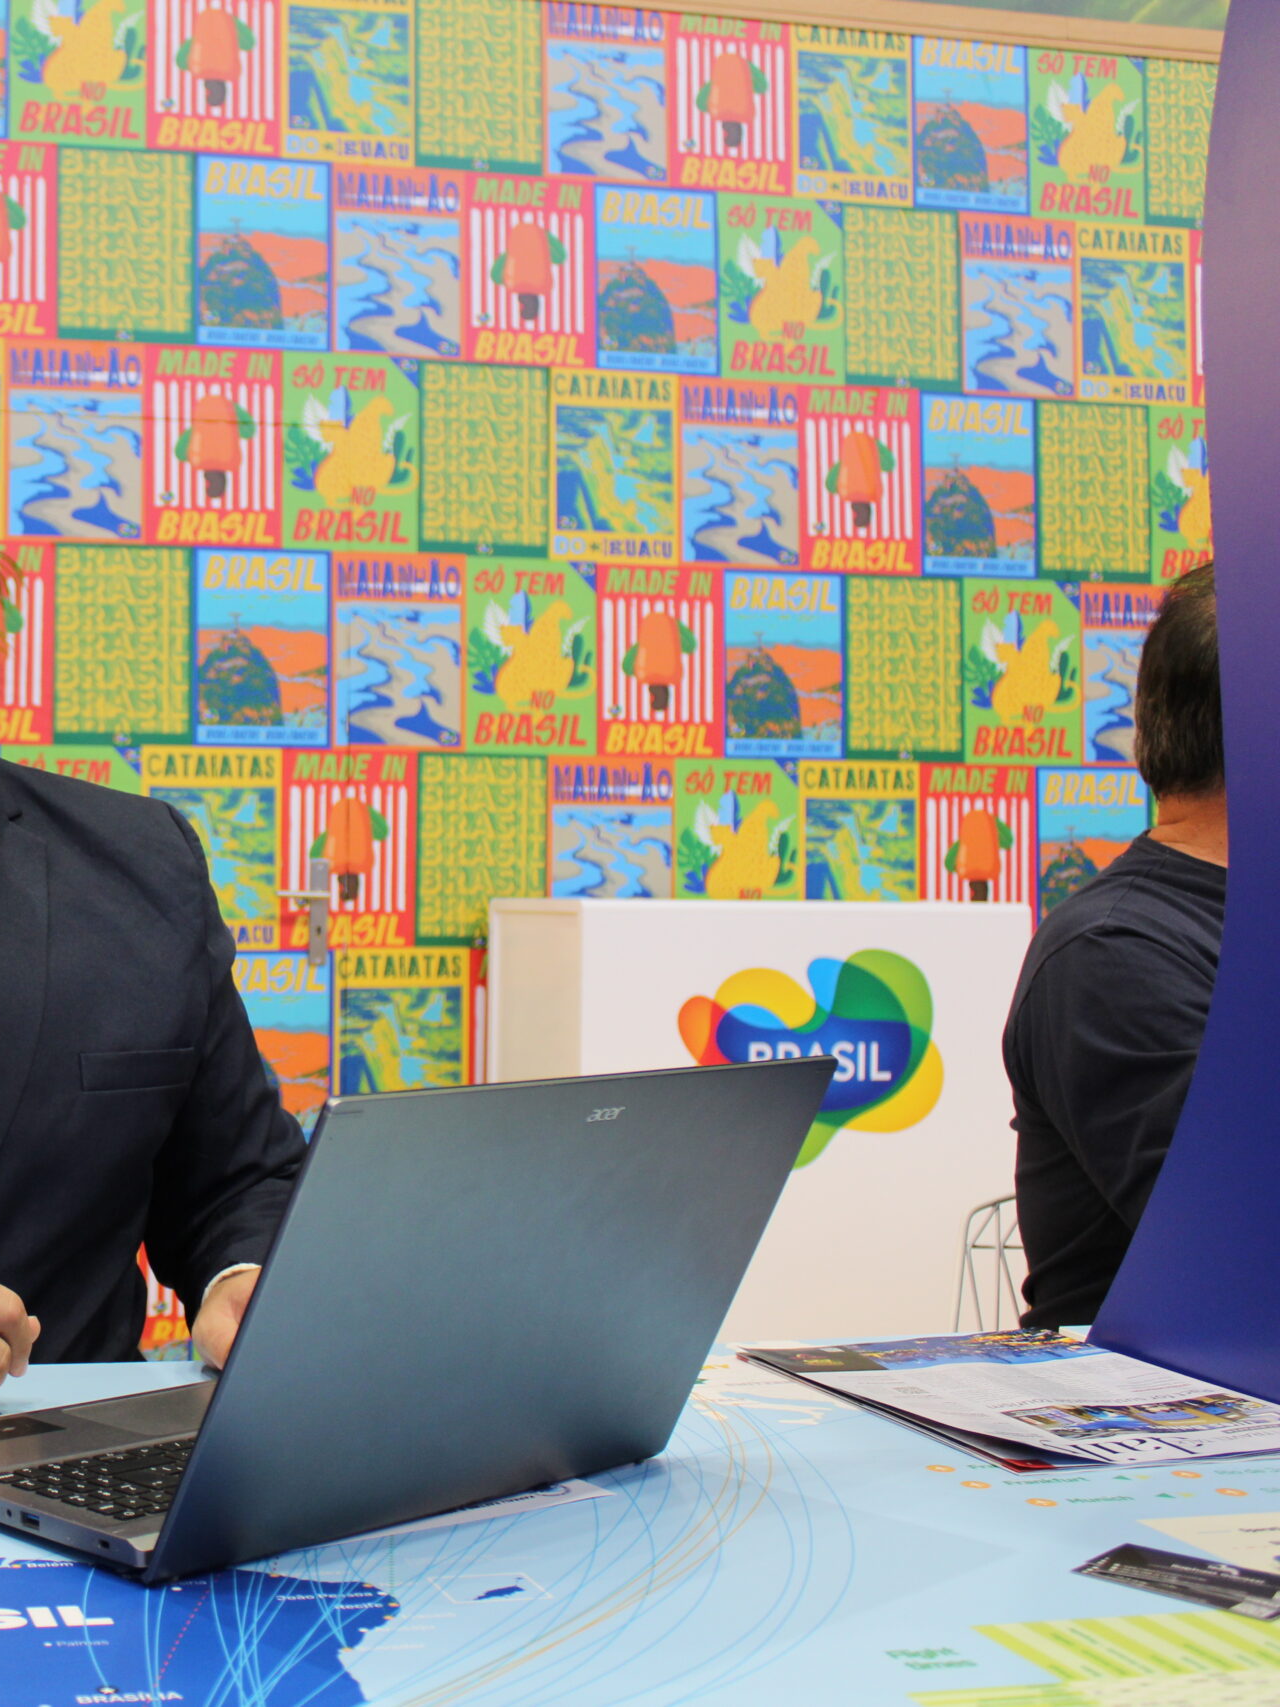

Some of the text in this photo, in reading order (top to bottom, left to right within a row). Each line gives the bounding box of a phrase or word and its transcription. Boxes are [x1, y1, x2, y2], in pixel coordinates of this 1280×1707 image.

[680, 13, 782, 41] MADE IN
[920, 36, 1021, 74] BRASIL
[1036, 50, 1118, 81] SÓ TEM
[80, 80, 107, 102] NO
[19, 101, 140, 140] BRASIL
[157, 116, 274, 153] BRASIL
[19, 145, 45, 172] IN
[285, 133, 320, 154] DO
[204, 161, 324, 200] BRASIL
[680, 157, 786, 193] BRASIL
[796, 172, 827, 194] DO
[1089, 164, 1110, 184] NO
[473, 178, 582, 209] MADE IN
[1040, 182, 1139, 219] BRASIL
[600, 190, 711, 230] BRASIL
[727, 203, 814, 233] SÓ TEM
[782, 321, 806, 341] NO
[473, 332, 585, 367] BRASIL
[730, 341, 835, 376] BRASIL
[155, 350, 274, 380] MADE IN
[292, 360, 387, 391] SÓ TEM
[808, 388, 908, 418] MADE IN
[1080, 379, 1111, 399] DO
[927, 399, 1029, 436] BRASIL
[1156, 413, 1184, 440] SÓ
[350, 486, 376, 507] NO
[157, 511, 275, 545] BRASIL
[292, 508, 409, 545] BRASIL
[553, 535, 587, 556] DO
[811, 539, 913, 571] BRASIL
[203, 555, 323, 592] BRASIL
[473, 567, 565, 597] SÓ TEM
[605, 568, 712, 598] MADE IN
[730, 576, 837, 612] BRASIL
[971, 588, 1052, 615] SÓ TEM
[530, 690, 556, 711] NO
[1022, 703, 1045, 724] NO
[473, 713, 587, 748] BRASIL
[606, 723, 713, 756] BRASIL
[973, 725, 1073, 759] BRASIL
[294, 754, 408, 781] MADE IN
[685, 768, 773, 795] SÓ TEM
[928, 767, 1028, 795] MADE IN
[1044, 773, 1144, 808] BRASIL
[585, 1106, 627, 1123] acer
[885, 1647, 959, 1660] Flight
[75, 1690, 184, 1706] BRASÍLIA
